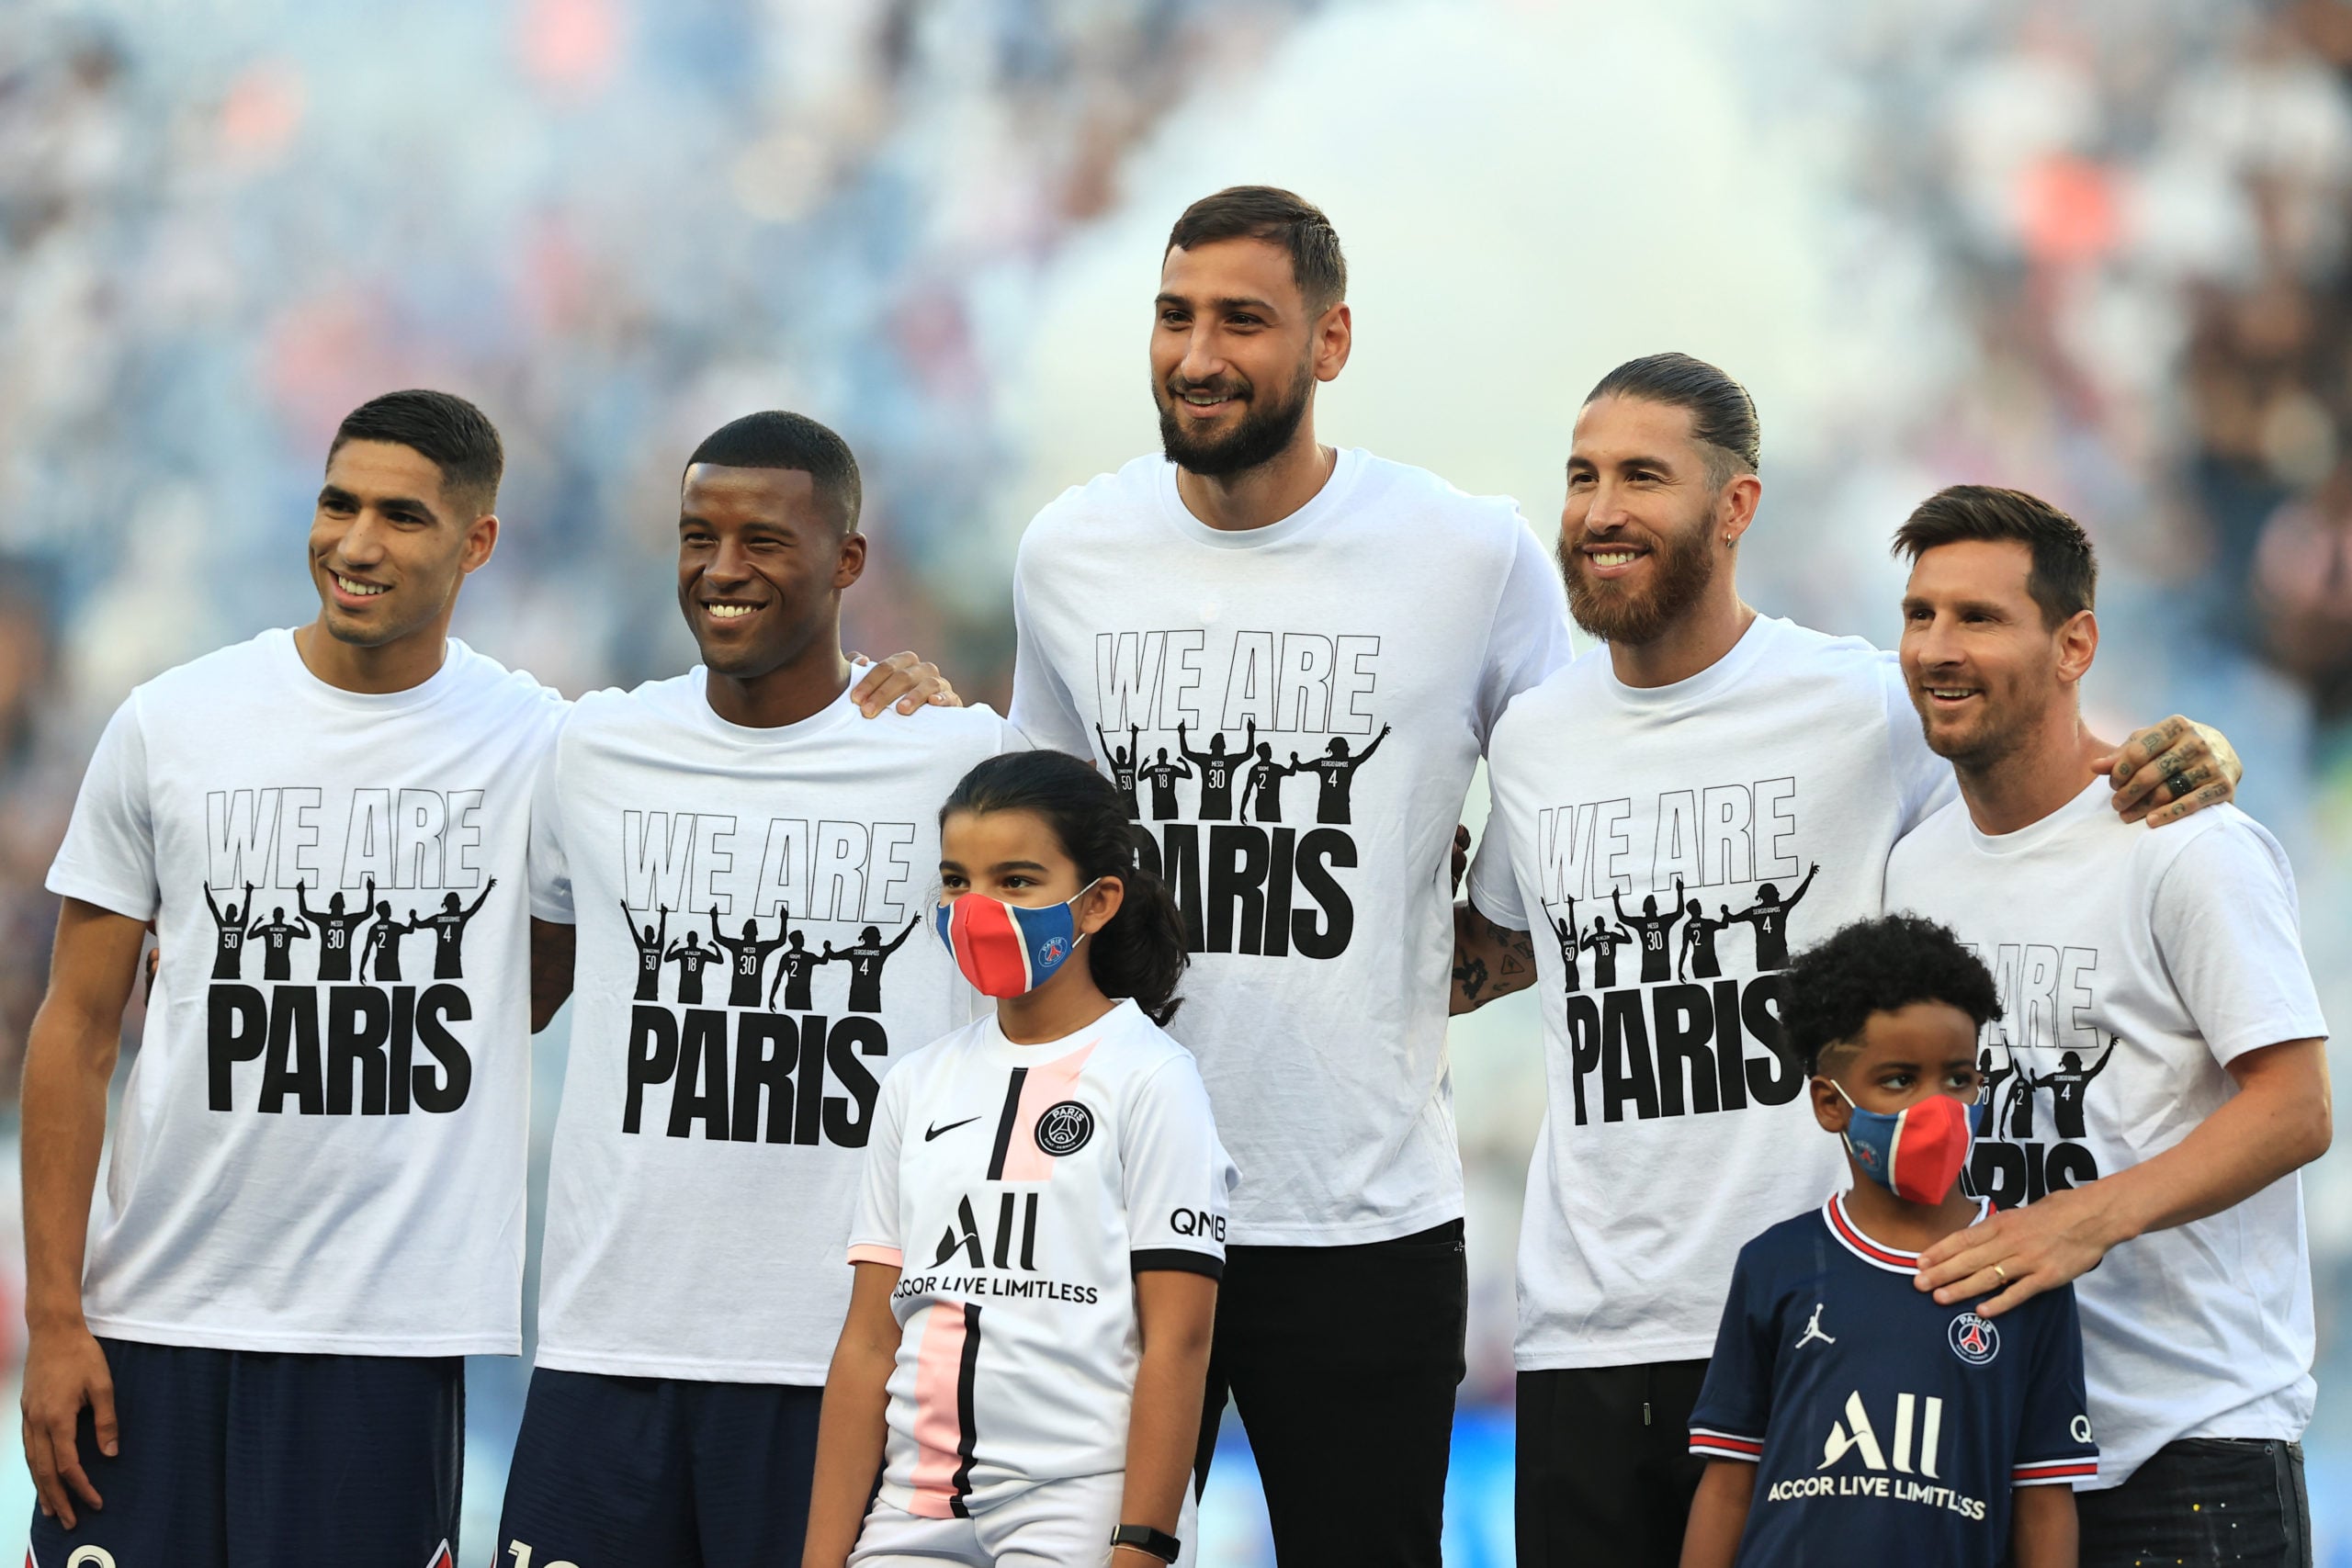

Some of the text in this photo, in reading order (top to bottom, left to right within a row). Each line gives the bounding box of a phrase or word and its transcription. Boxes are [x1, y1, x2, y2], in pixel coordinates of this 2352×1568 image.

[1096, 629, 1380, 735] WE ARE
[1121, 775, 1132, 790] 50
[1158, 773, 1168, 788] 18
[1208, 769, 1226, 789] 30
[1259, 773, 1267, 789] 2
[1328, 769, 1338, 787] 4
[207, 787, 485, 890] WE ARE
[1539, 776, 1798, 906] WE ARE
[623, 810, 915, 924] WE ARE
[443, 924, 452, 942] 4
[1762, 915, 1772, 934] 4
[224, 933, 238, 949] 50
[272, 933, 283, 949] 18
[327, 929, 345, 949] 30
[378, 931, 386, 949] 2
[1646, 931, 1663, 951] 30
[1693, 930, 1702, 946] 2
[1565, 946, 1575, 962] 50
[1600, 942, 1610, 955] 18
[645, 955, 656, 970] 50
[687, 957, 697, 972] 18
[740, 955, 756, 976] 30
[789, 961, 798, 977] 2
[859, 958, 869, 976] 4
[208, 983, 472, 1115] PARIS
[1566, 975, 1804, 1126] PARIS
[622, 1004, 888, 1148] PARIS
[2016, 1089, 2024, 1105] 2
[2061, 1083, 2071, 1101] 4
[1052, 1108, 1084, 1122] PARIS
[1170, 1207, 1226, 1243] QNB
[942, 1277, 987, 1294] LIVE
[991, 1278, 1098, 1304] LIMITLESS
[1768, 1476, 1835, 1502] ACCOR
[1839, 1475, 1890, 1497] LIVE
